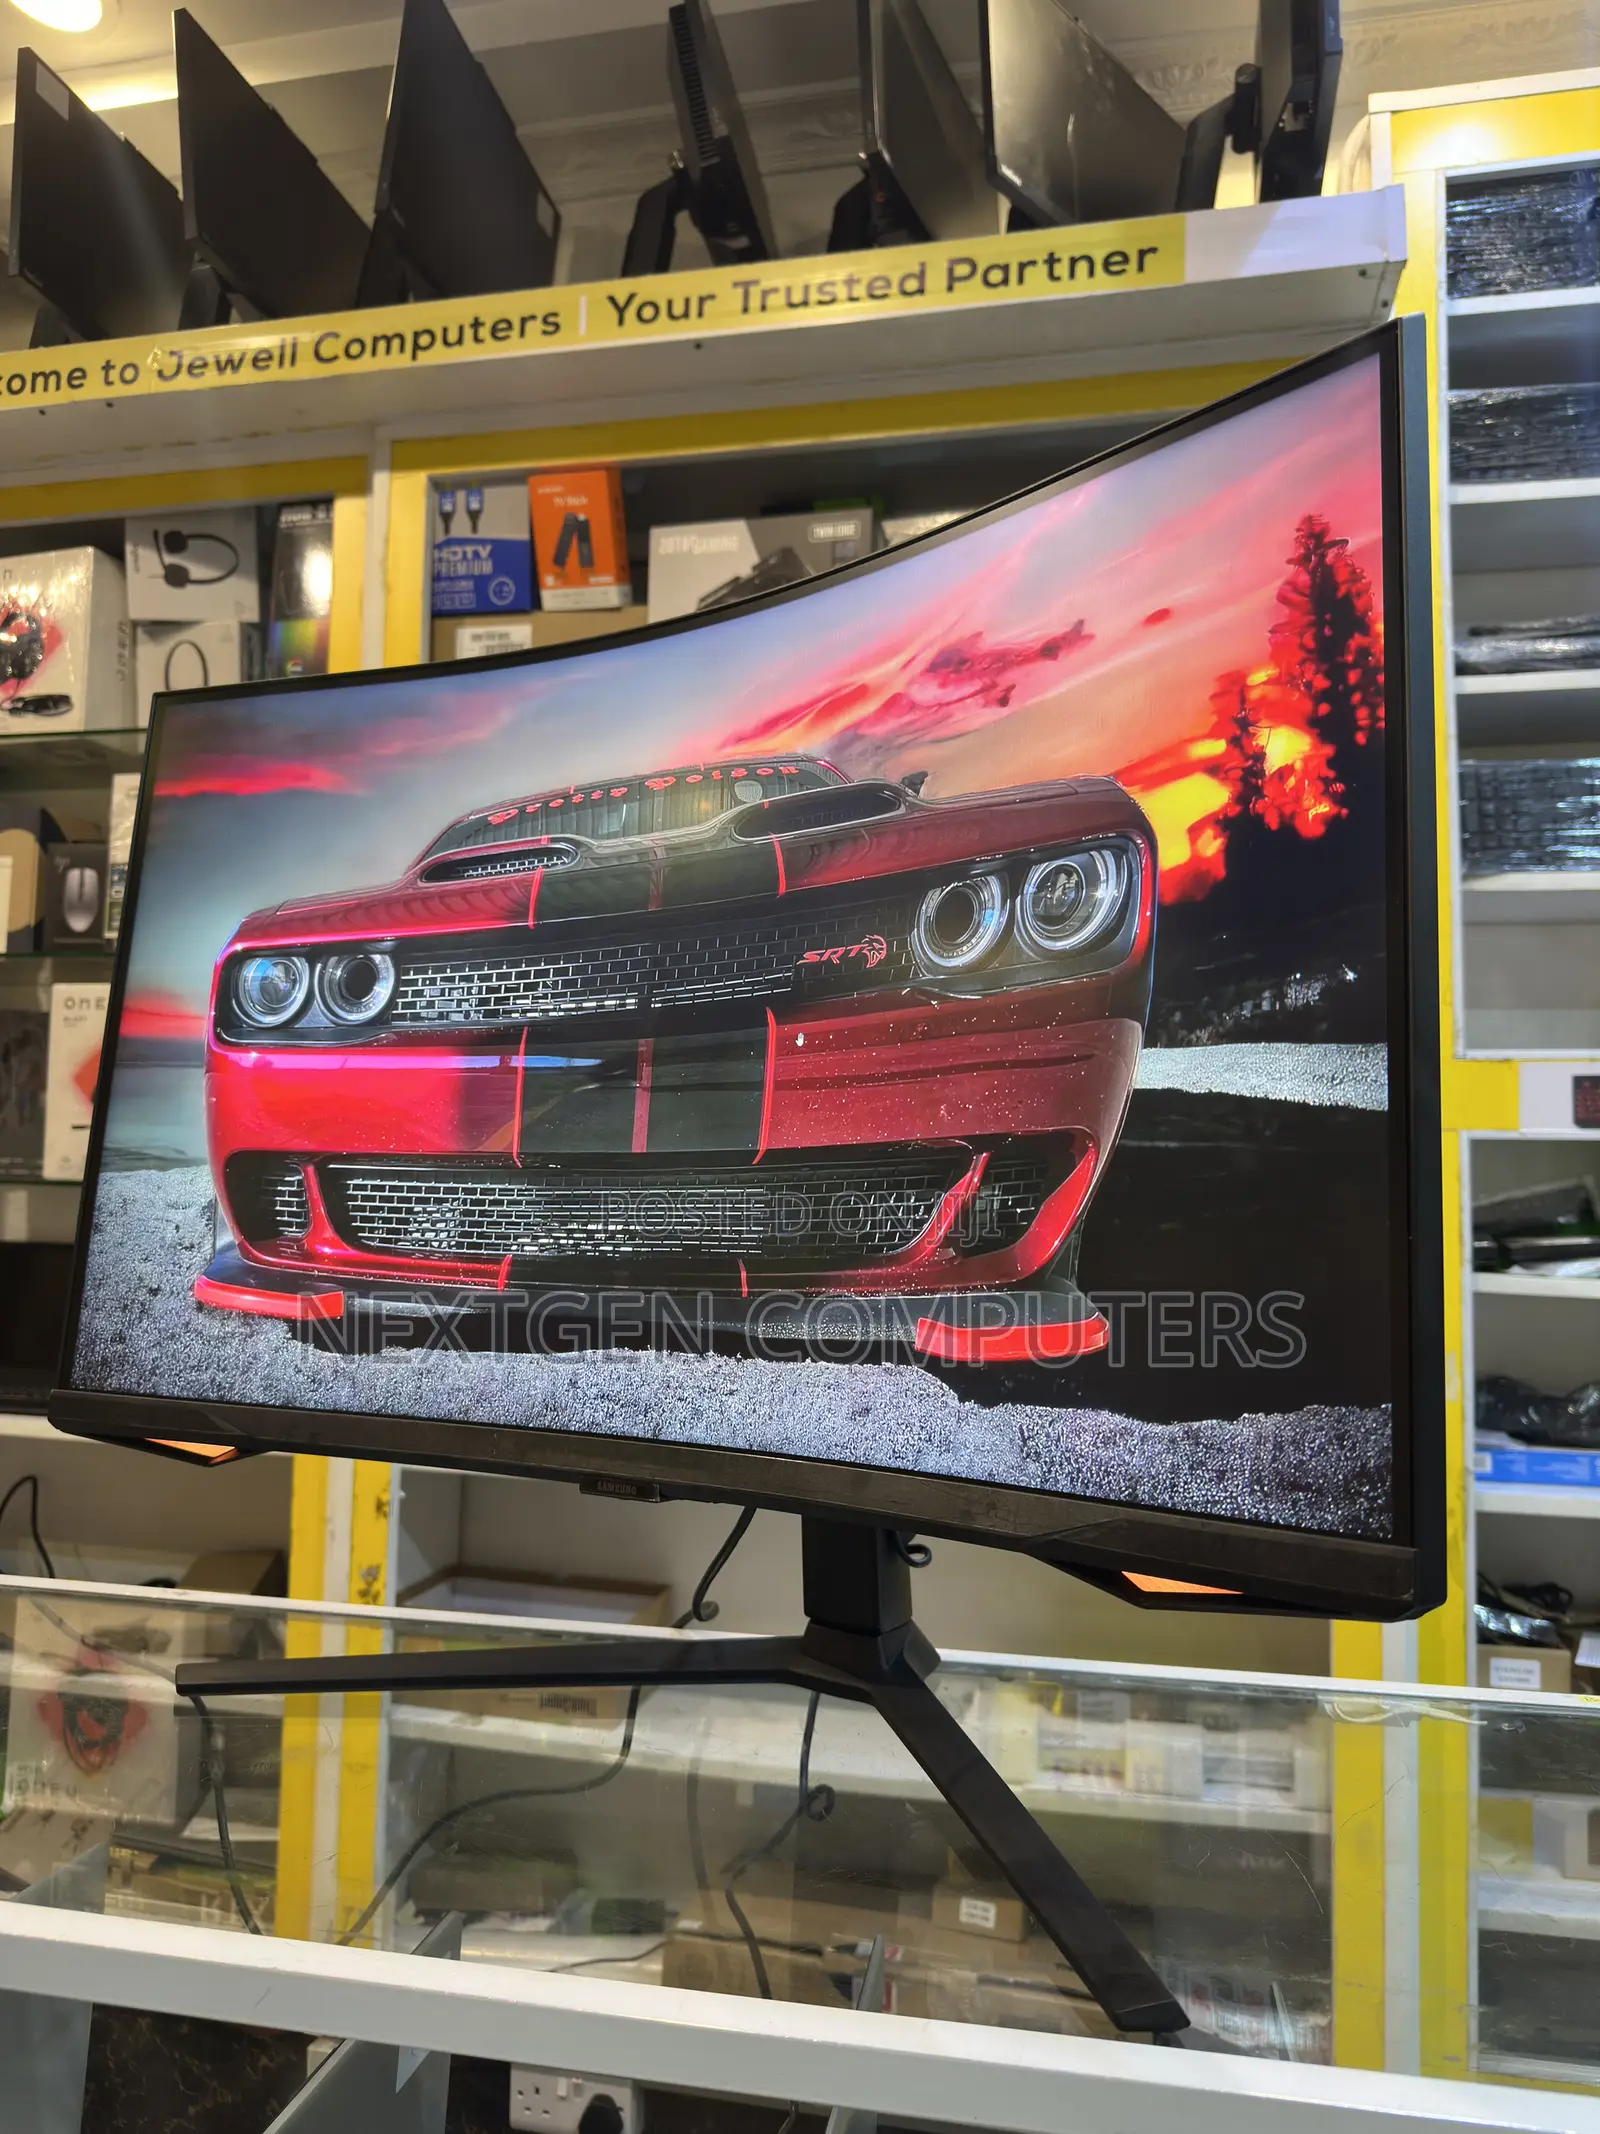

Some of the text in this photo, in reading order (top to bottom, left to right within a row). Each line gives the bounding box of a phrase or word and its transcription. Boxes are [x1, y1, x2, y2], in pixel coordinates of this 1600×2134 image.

[0, 244, 1159, 396] ome to Jewell Computers Your Trusted Partner
[433, 543, 493, 562] HDTV
[433, 558, 494, 578] PREMIUM
[796, 943, 869, 965] SRT
[597, 1480, 637, 1495] SAMSUNG
